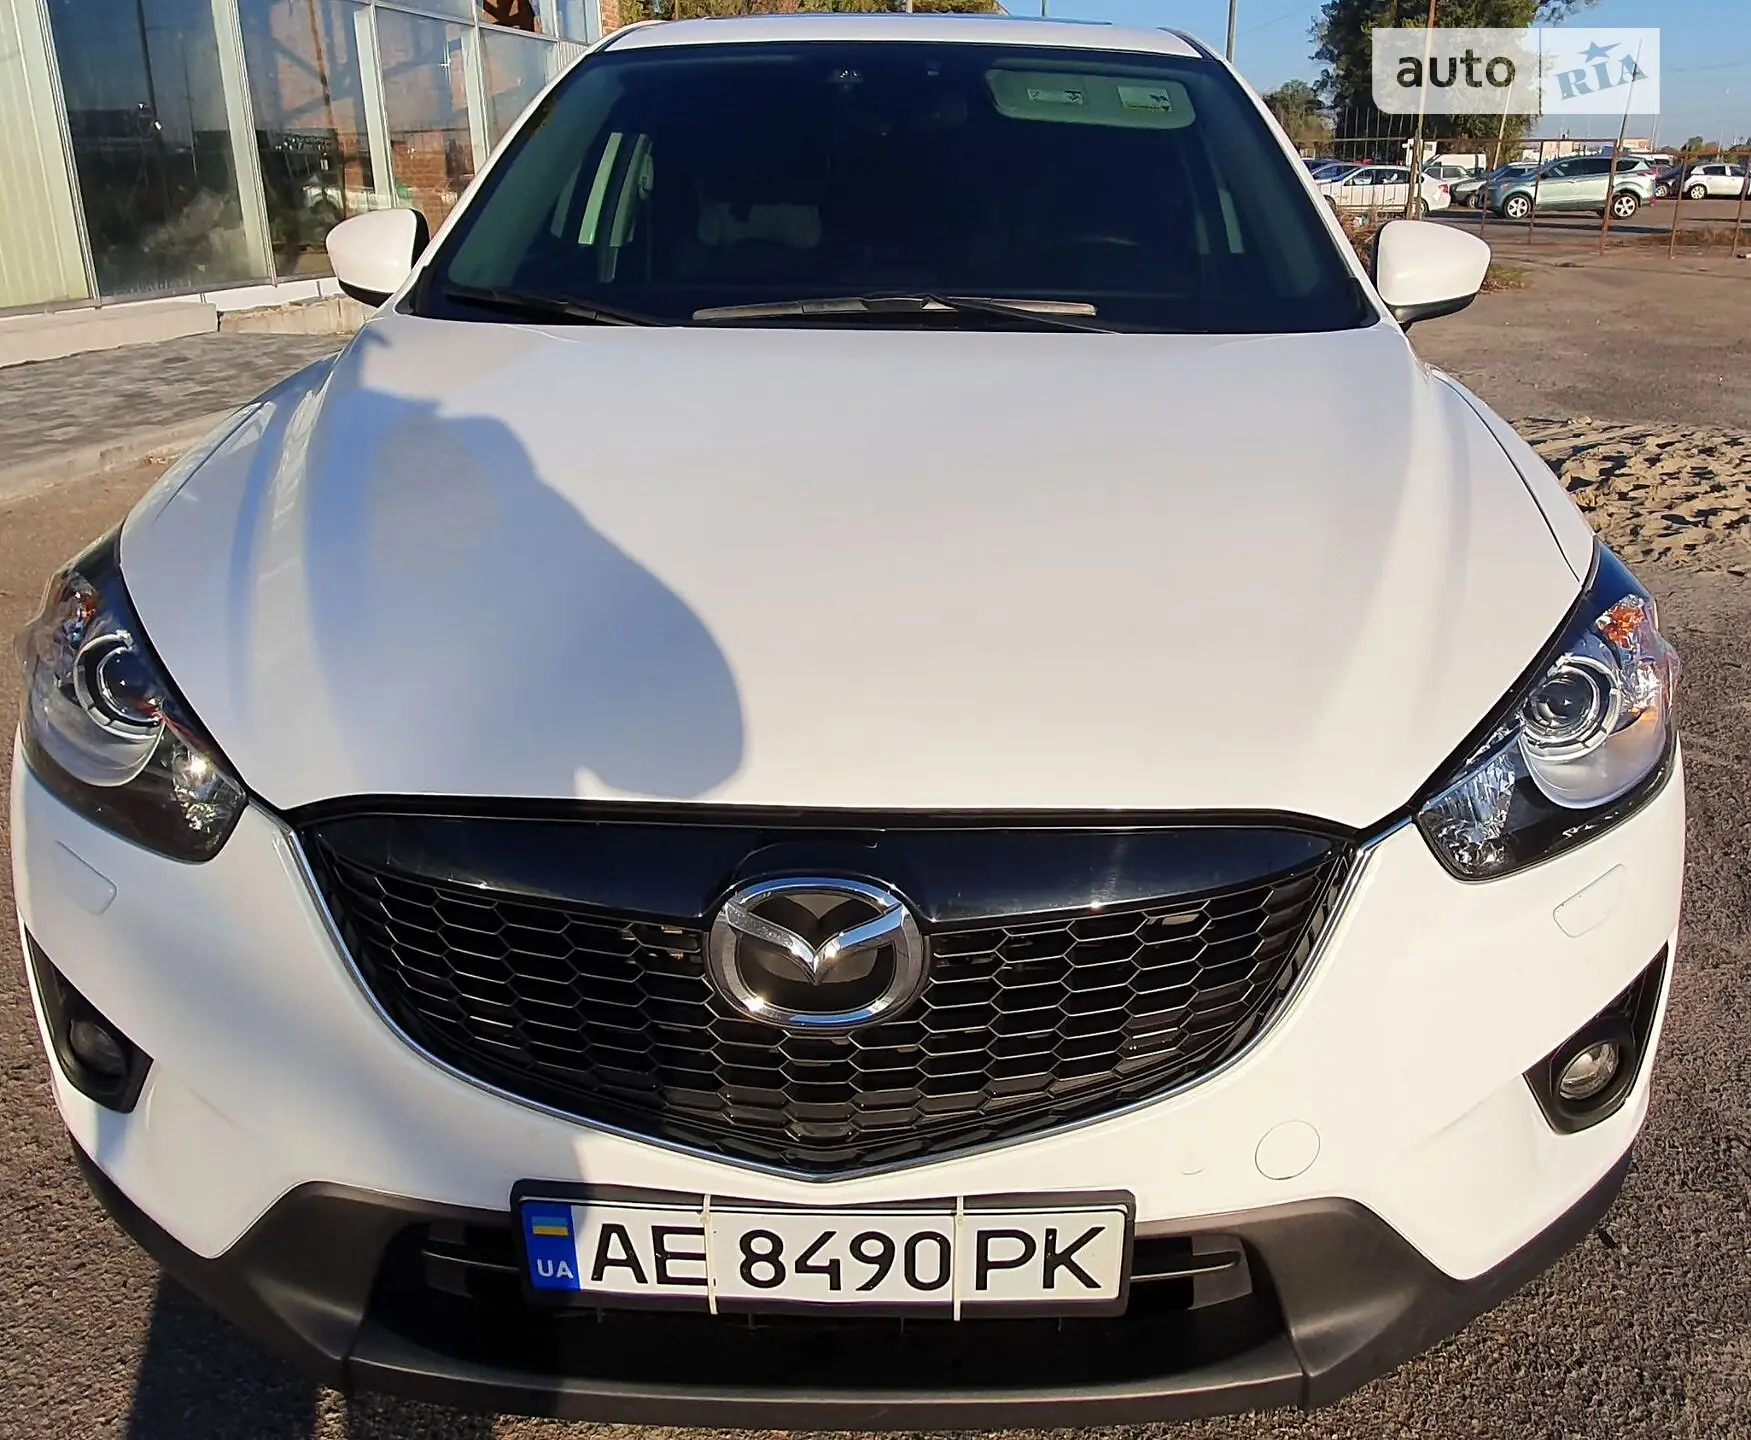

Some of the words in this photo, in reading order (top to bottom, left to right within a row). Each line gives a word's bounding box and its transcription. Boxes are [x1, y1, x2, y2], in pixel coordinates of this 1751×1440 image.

[537, 1260, 574, 1281] UA
[590, 1223, 708, 1286] AE
[738, 1230, 953, 1292] 8490
[975, 1226, 1106, 1291] PK
